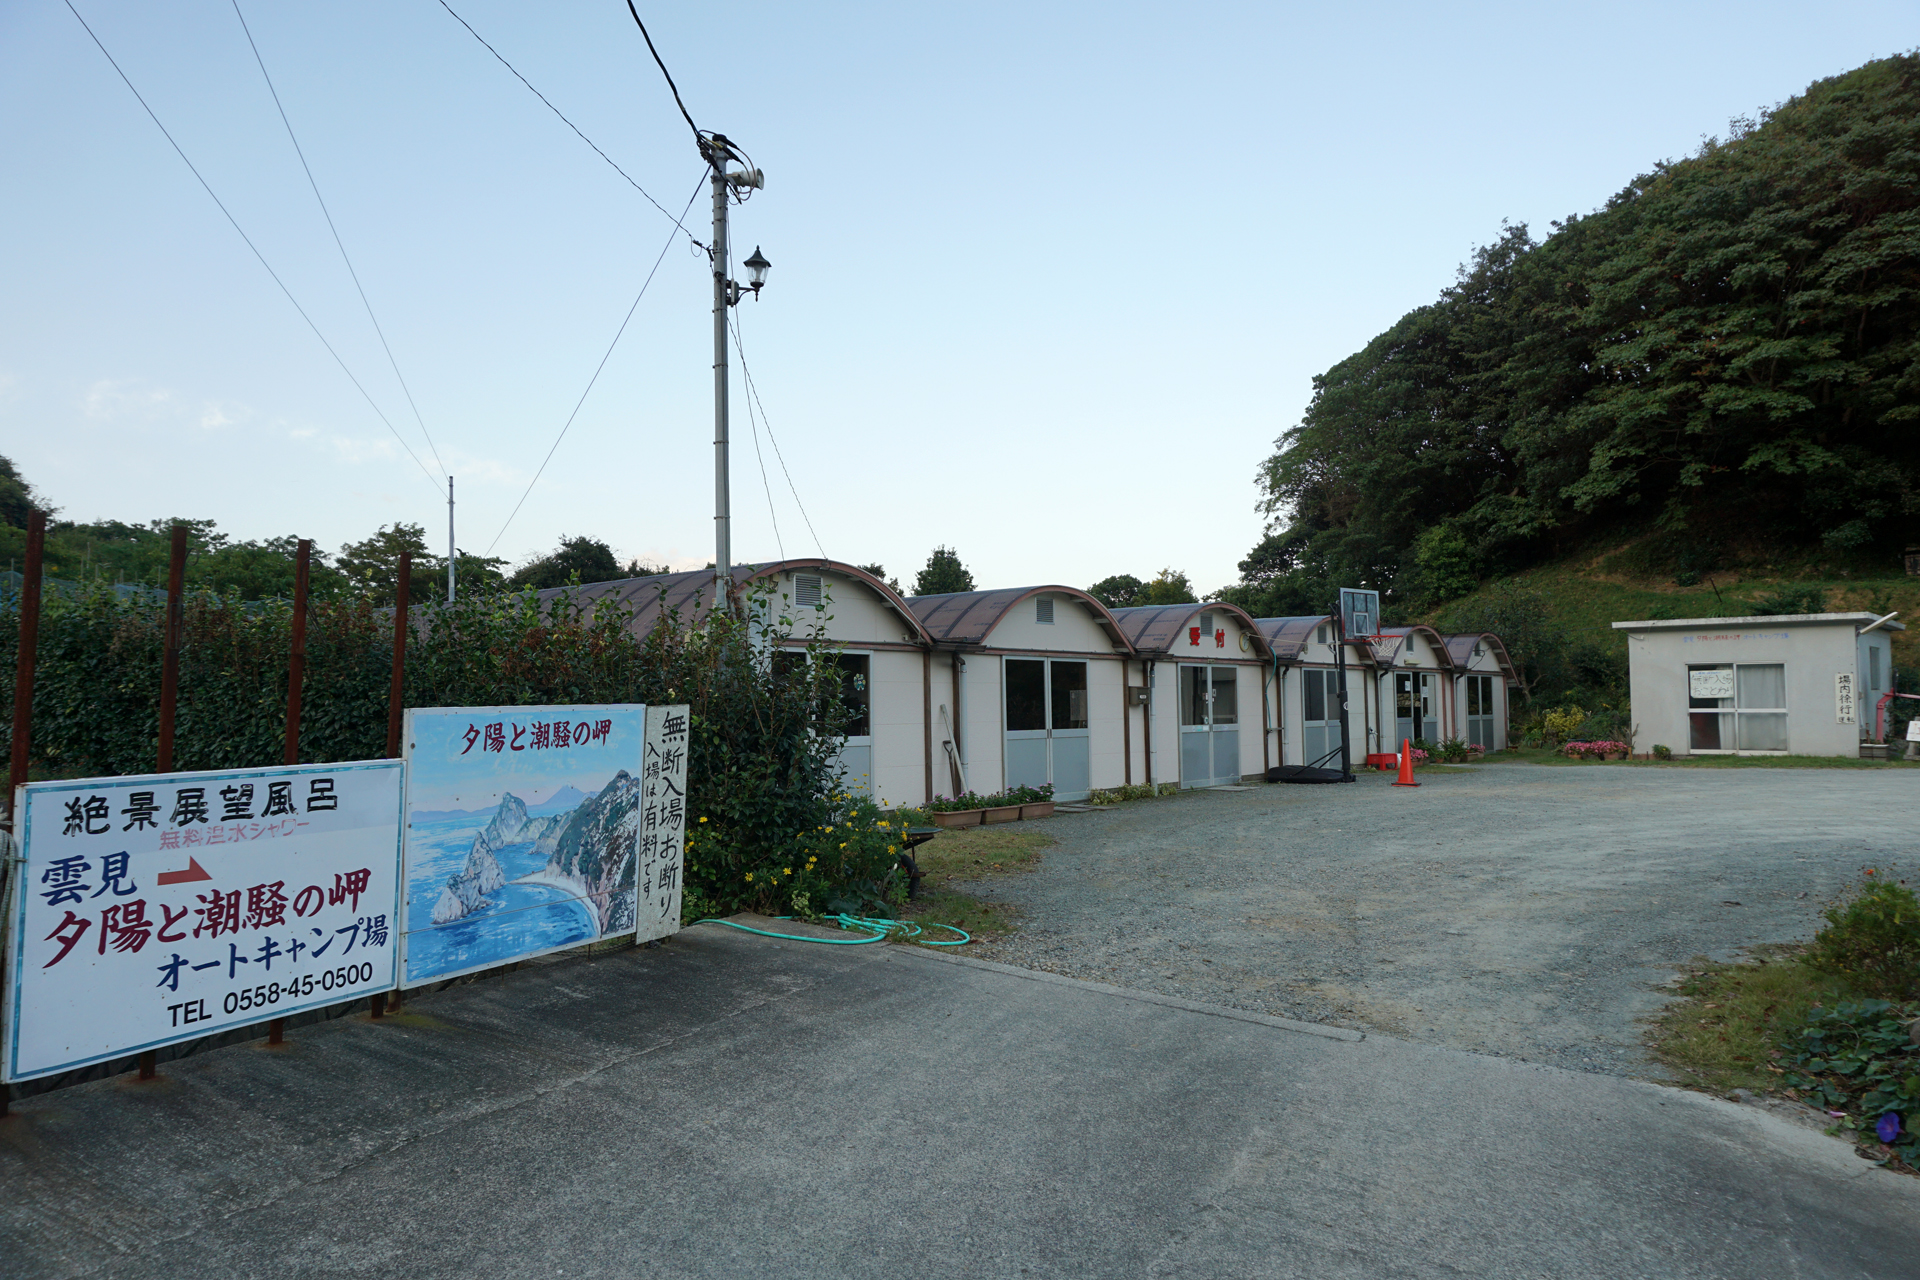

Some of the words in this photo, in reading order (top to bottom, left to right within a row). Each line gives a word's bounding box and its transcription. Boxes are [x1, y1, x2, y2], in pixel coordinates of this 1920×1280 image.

[1189, 627, 1225, 648] 受付
[1838, 674, 1852, 715] 場内徐行
[460, 718, 612, 755] 夕陽と潮騒の岬
[62, 778, 338, 837] 絶景展望風呂
[40, 850, 137, 906] 雲見
[41, 867, 372, 969] 夕陽と潮騒の岬
[156, 913, 389, 992] オートキャンプ場
[167, 998, 212, 1027] TEL
[223, 961, 373, 1014] 0558-45-0500
